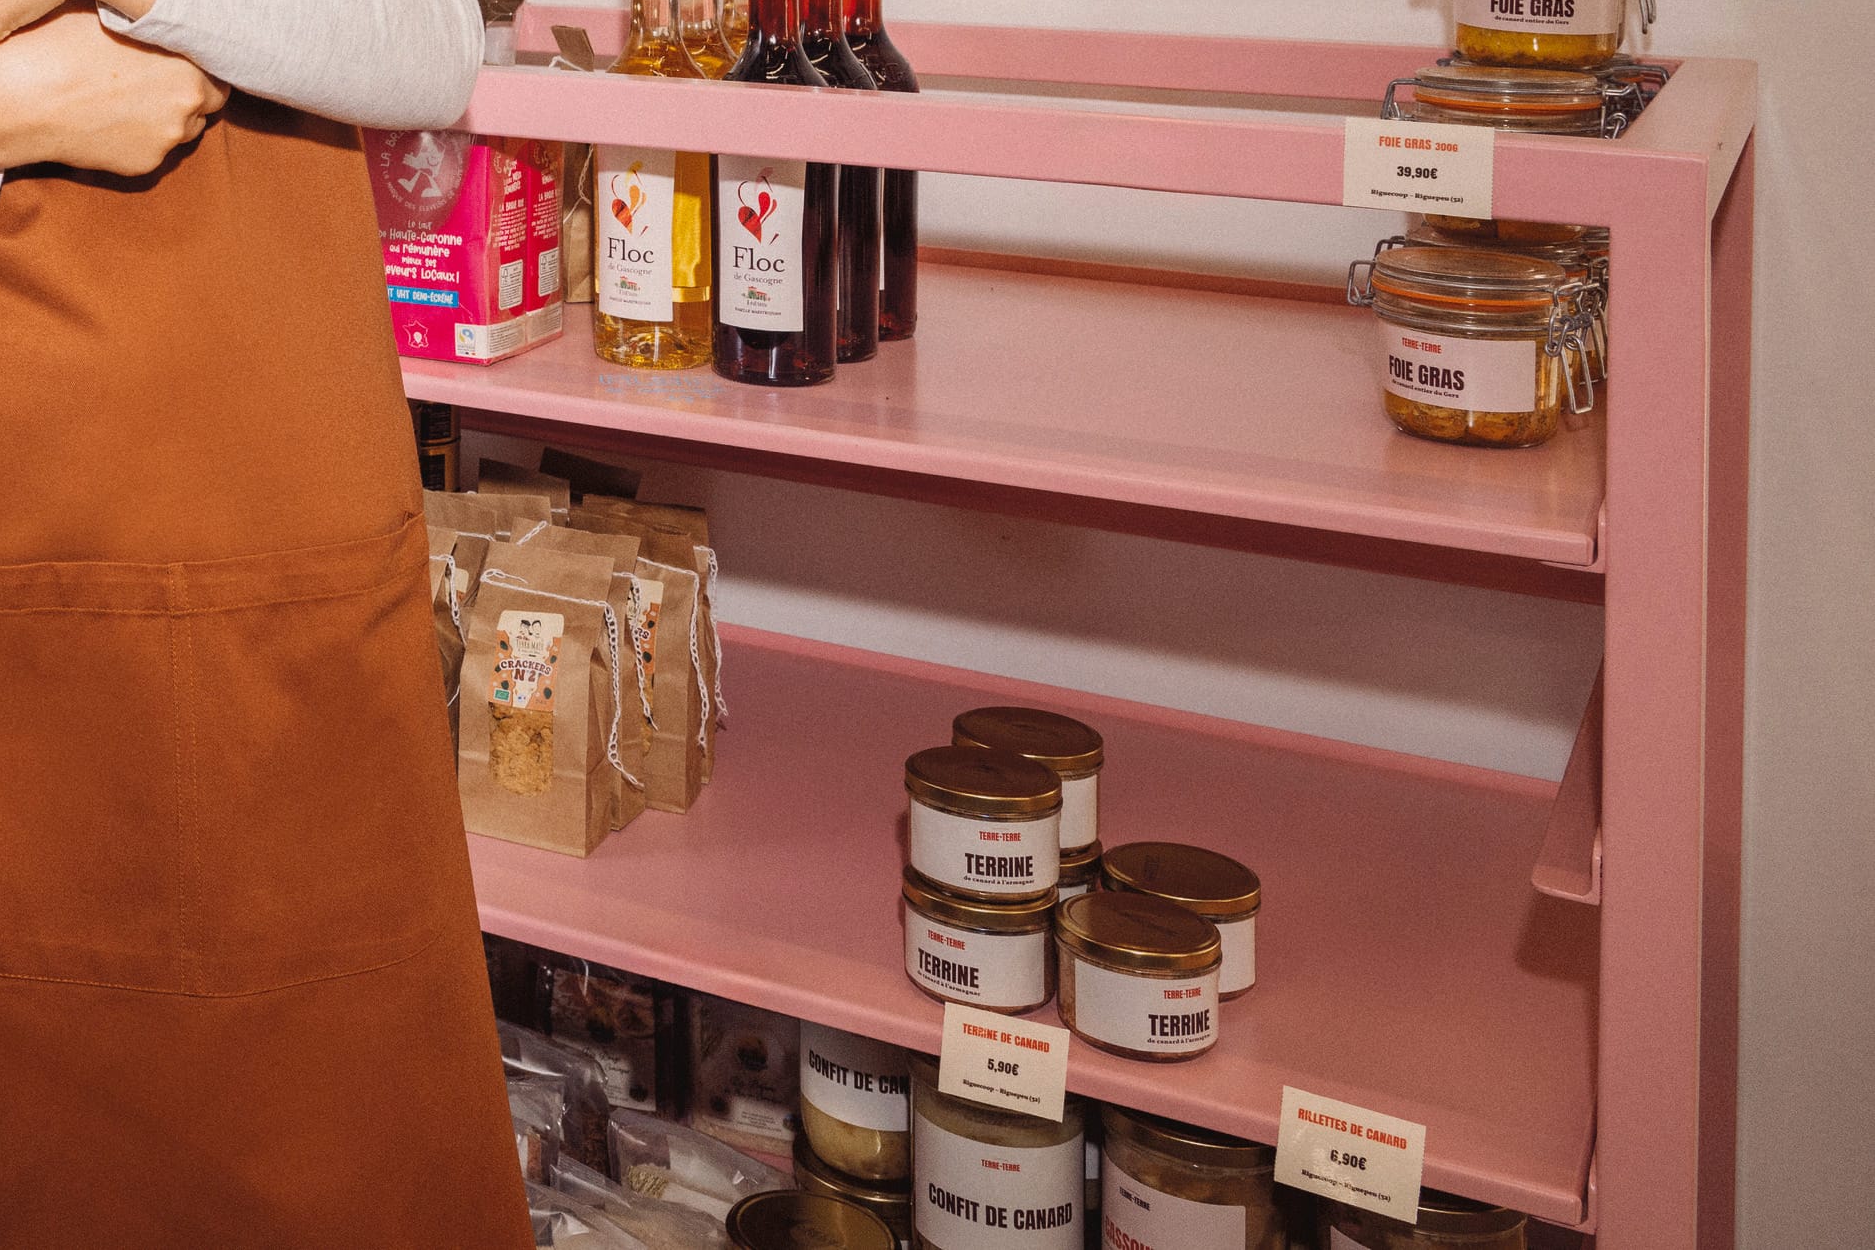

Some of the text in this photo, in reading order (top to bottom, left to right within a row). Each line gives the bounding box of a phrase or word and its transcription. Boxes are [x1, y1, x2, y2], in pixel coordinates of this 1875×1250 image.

[1379, 135, 1401, 148] FOIE
[1404, 138, 1432, 151] GRAS
[1397, 165, 1438, 180] 39,90€
[607, 237, 655, 264] Floc
[732, 245, 786, 273] Floc
[616, 263, 653, 279] Gascogne
[733, 271, 784, 286] de Gascogne
[1401, 337, 1442, 354] TERRE-TERRE
[1389, 354, 1465, 391] FOIE GRAS
[500, 659, 552, 675] CRACKERS
[979, 830, 1021, 842] TERRE-TERRE
[964, 853, 1033, 878] TERRINE
[927, 929, 966, 950] TERRE-TERRE
[918, 947, 980, 989] TERRINE
[1164, 986, 1202, 999] TERRE-TERRE
[1148, 1008, 1210, 1037] TERRINE
[962, 1023, 1050, 1053] TERRINE DE CANARD
[808, 1048, 910, 1095] CONFIT DE CAN
[987, 1058, 1019, 1076] 5,90€
[1297, 1108, 1407, 1150] RILLETTES DE CANARD
[981, 1158, 1021, 1172] TERRE-TERRE
[1330, 1149, 1367, 1171] 6,90€
[928, 1182, 1073, 1230] CONFIT DE CANARD
[1119, 1186, 1151, 1212] TERRE-TERRE
[1105, 1214, 1153, 1250] CASSO
